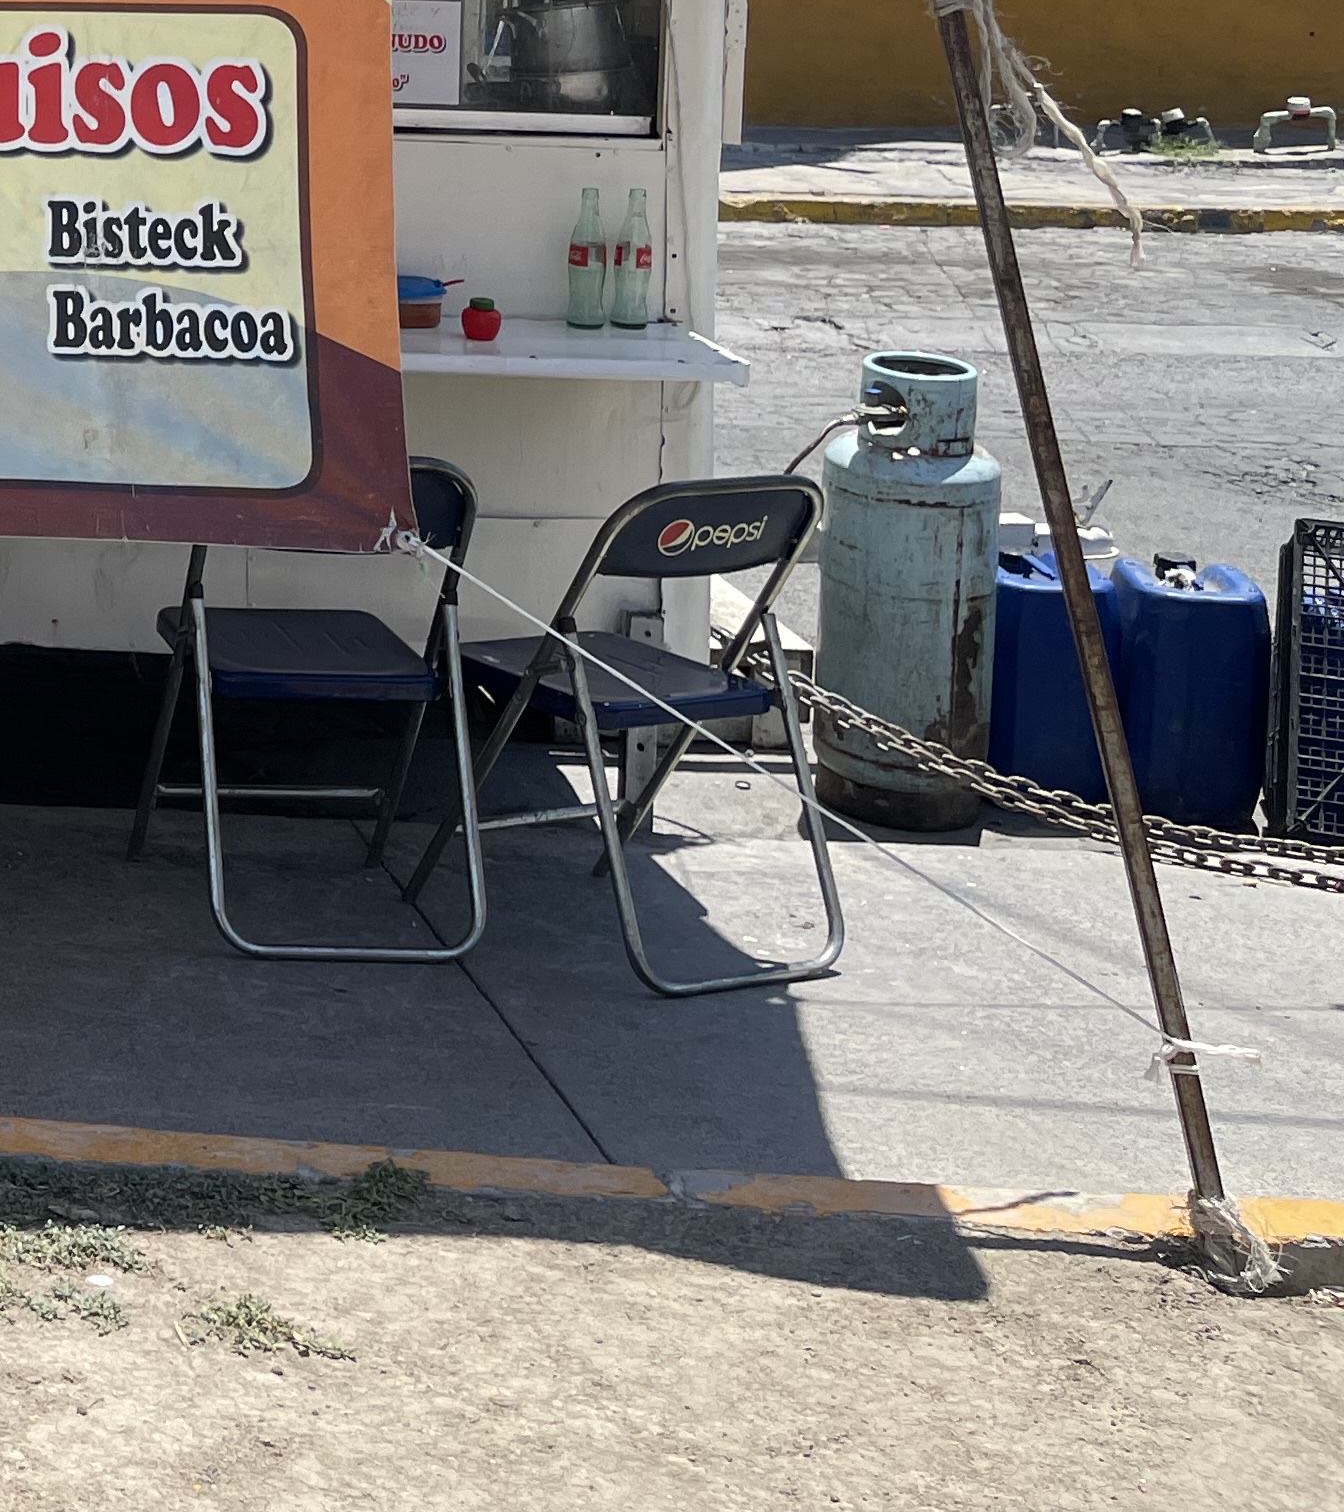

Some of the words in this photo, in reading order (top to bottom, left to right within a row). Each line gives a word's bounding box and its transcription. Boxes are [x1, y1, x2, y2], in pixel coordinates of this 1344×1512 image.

[45, 198, 239, 263] Bisteck
[51, 288, 290, 357] Barbacoa
[690, 514, 769, 552] pepsi
